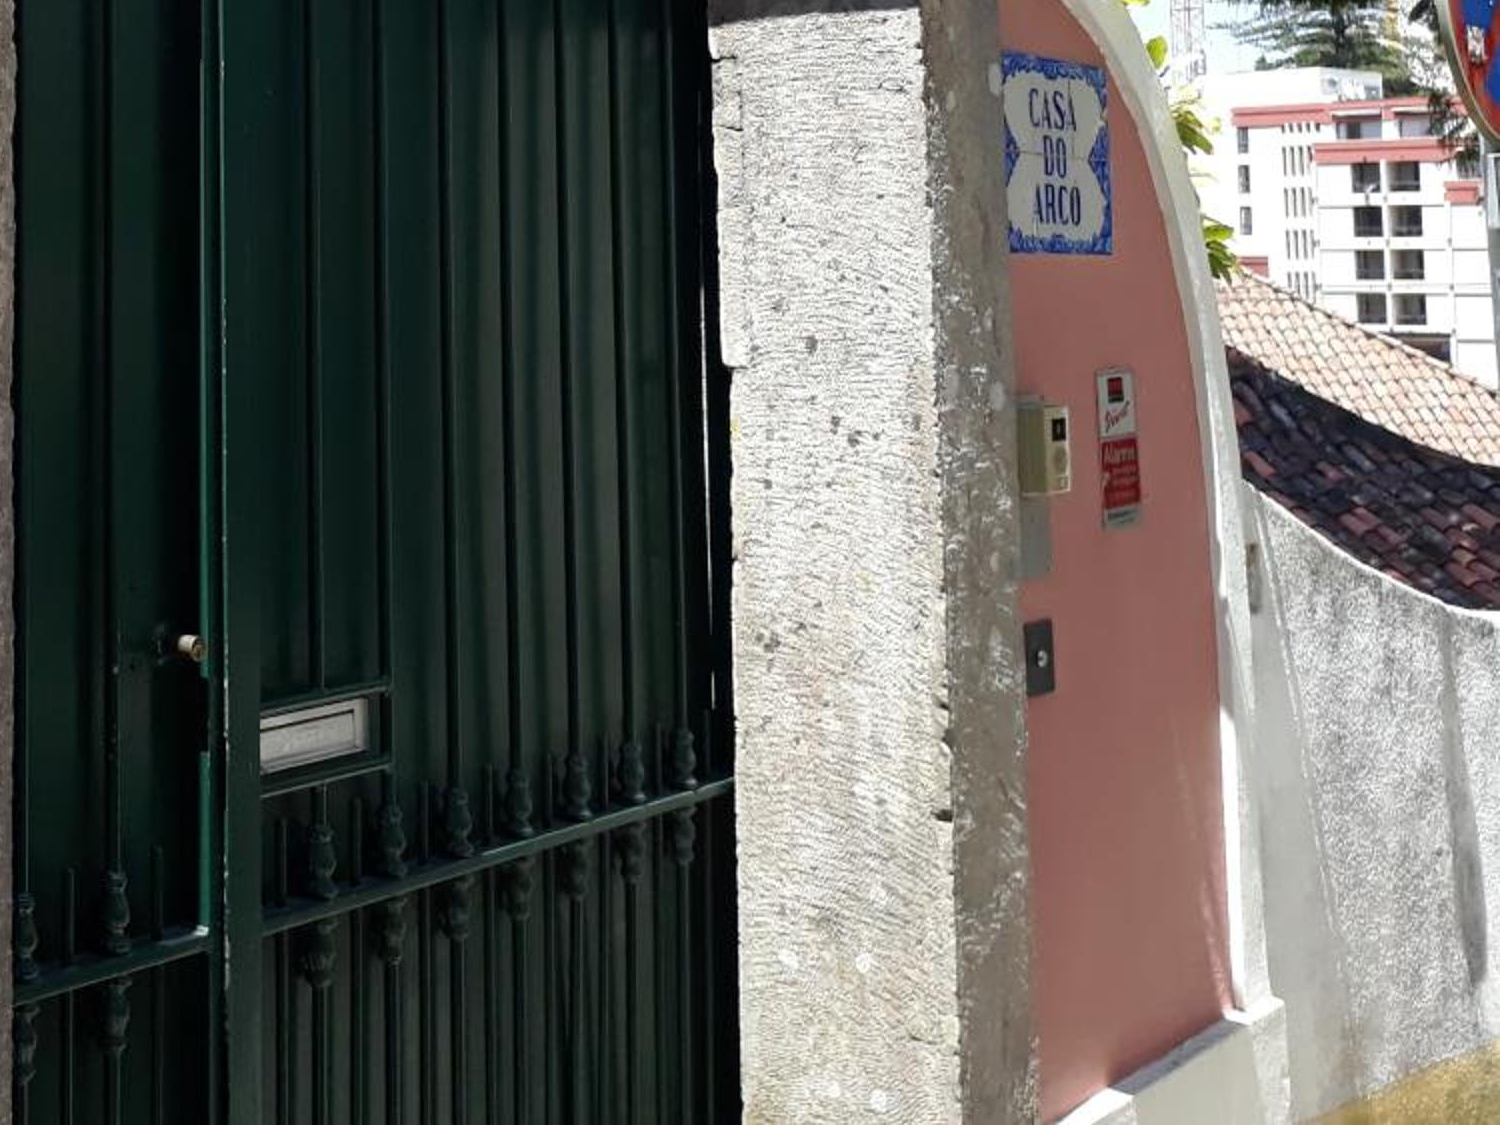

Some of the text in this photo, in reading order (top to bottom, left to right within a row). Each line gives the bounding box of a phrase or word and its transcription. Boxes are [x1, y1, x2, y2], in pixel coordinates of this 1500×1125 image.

[1028, 87, 1077, 132] CASA
[1042, 134, 1067, 179] DO
[1033, 183, 1081, 226] ARCO
